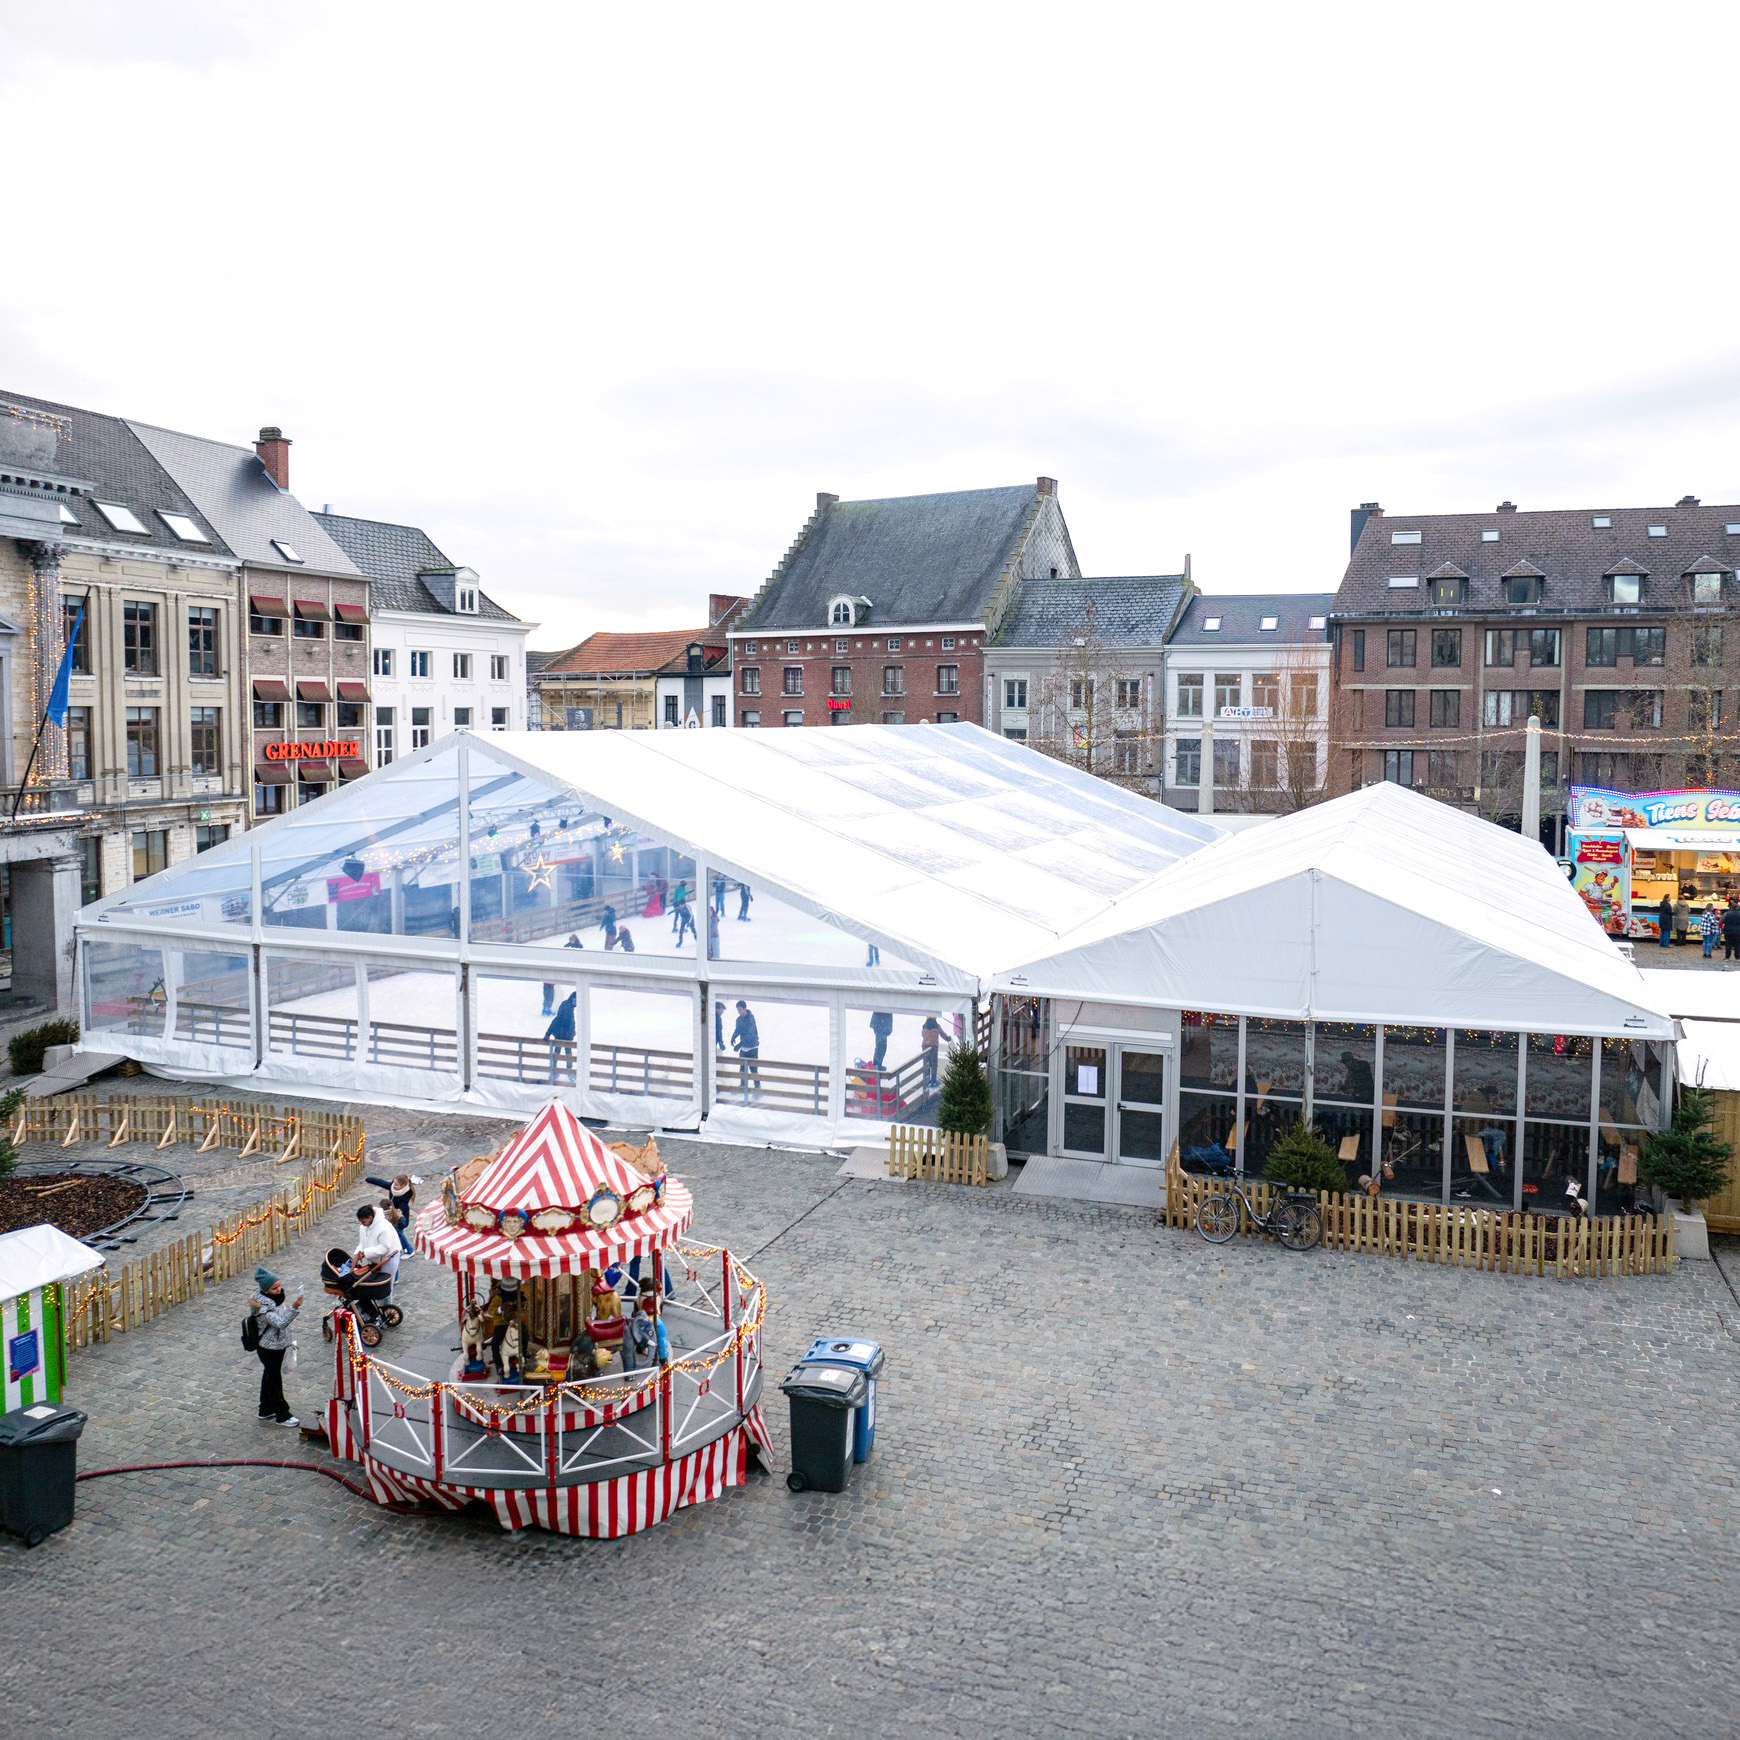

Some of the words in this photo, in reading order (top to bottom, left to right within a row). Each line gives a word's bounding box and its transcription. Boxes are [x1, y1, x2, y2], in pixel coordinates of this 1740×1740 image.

[827, 699, 851, 709] Duvel
[265, 741, 360, 760] GRENADIER
[1645, 802, 1698, 824] Tiens
[149, 906, 179, 916] WERNER
[180, 903, 200, 912] SABO
